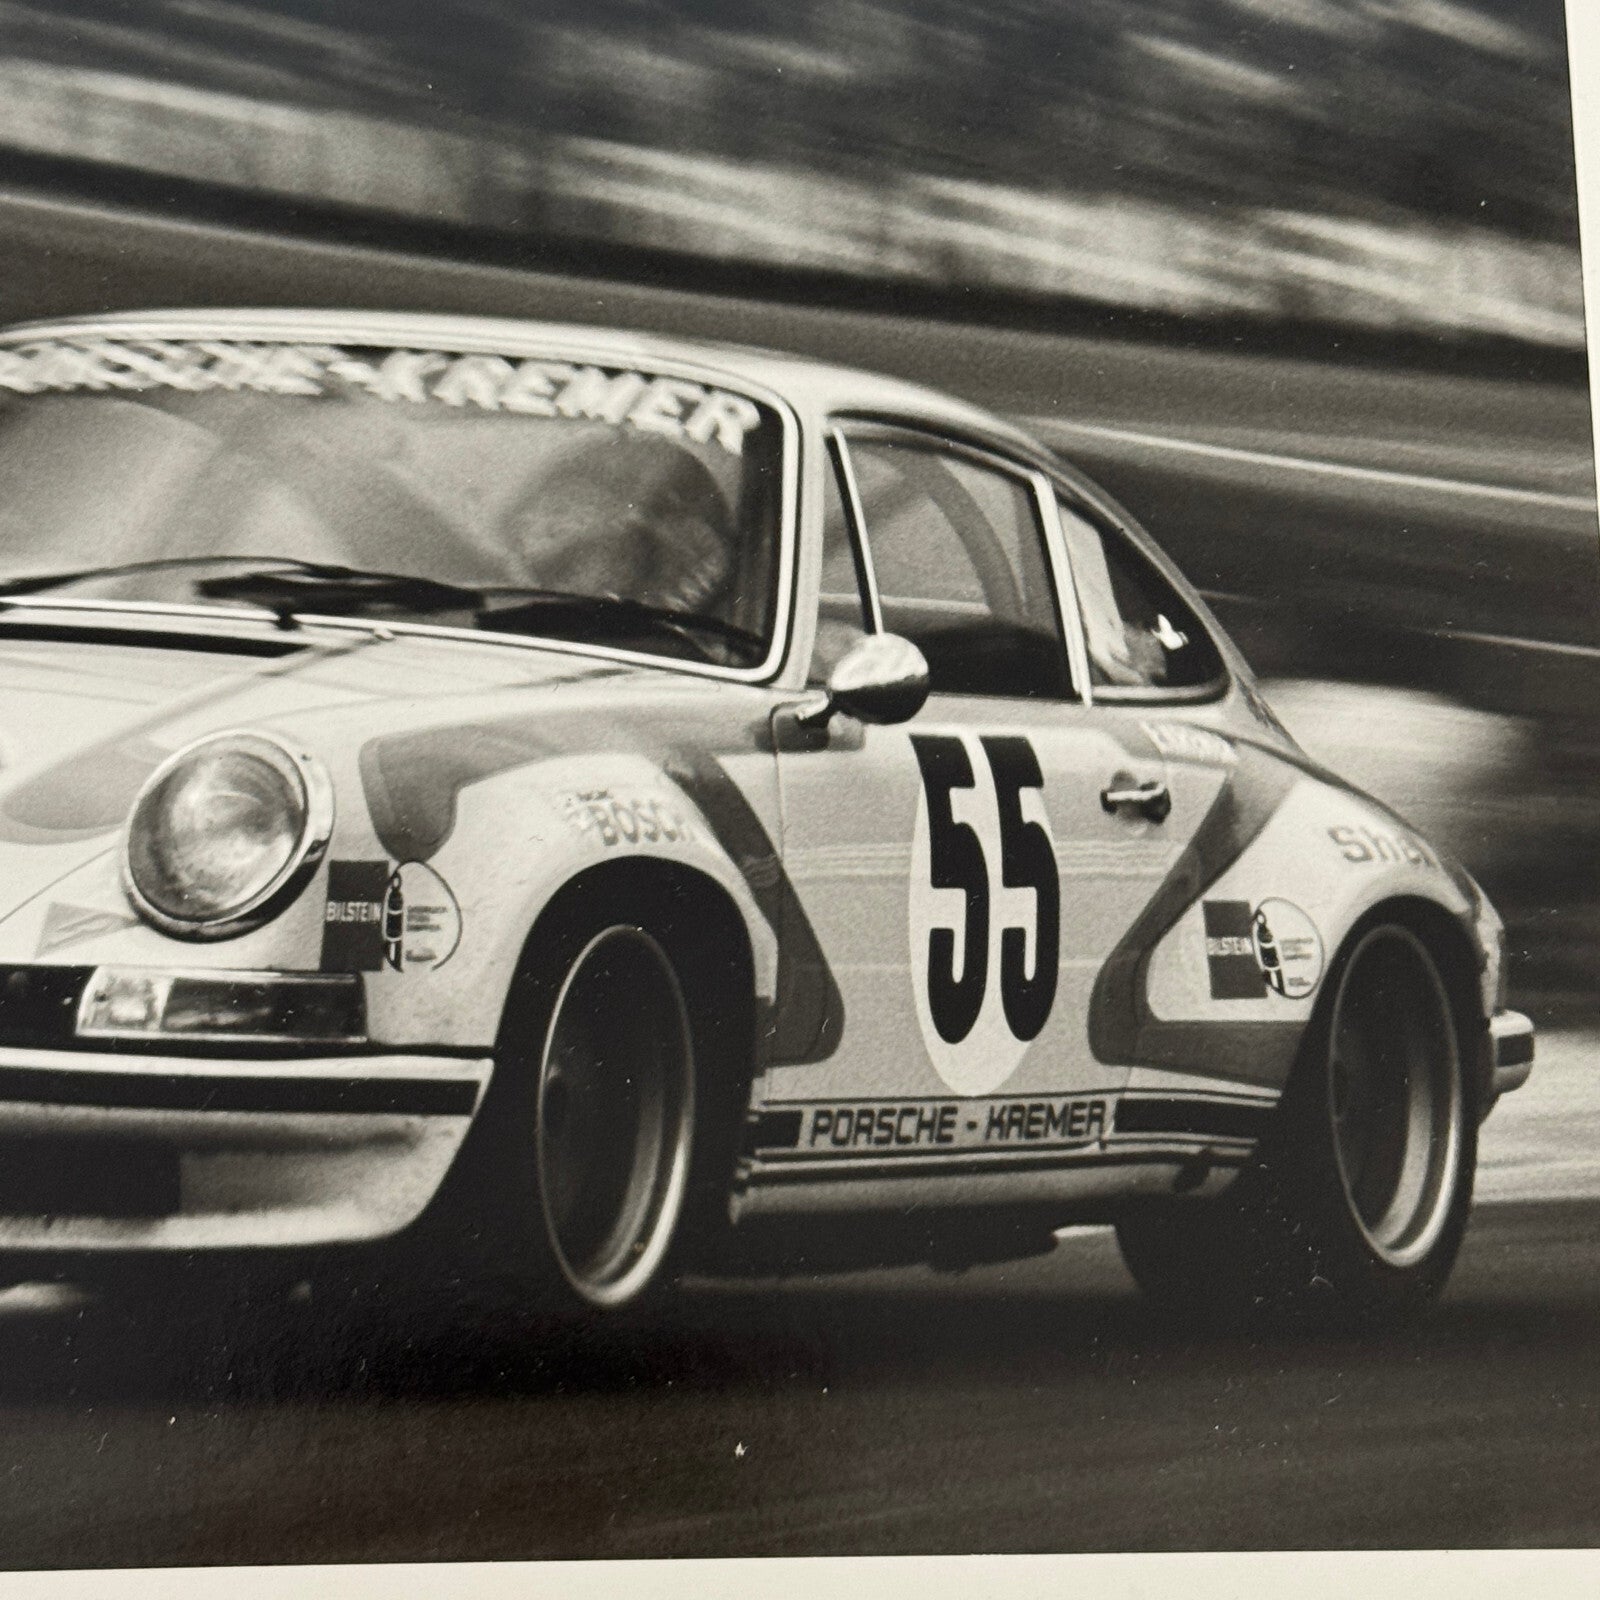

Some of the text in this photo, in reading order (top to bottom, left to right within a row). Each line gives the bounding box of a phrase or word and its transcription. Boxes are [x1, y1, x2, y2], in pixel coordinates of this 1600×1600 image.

[370, 349, 762, 456] KREMER
[326, 901, 382, 922] BILSTEIN
[909, 733, 1060, 1044] 55
[809, 1099, 1107, 1148] PORSCHE KREMER
